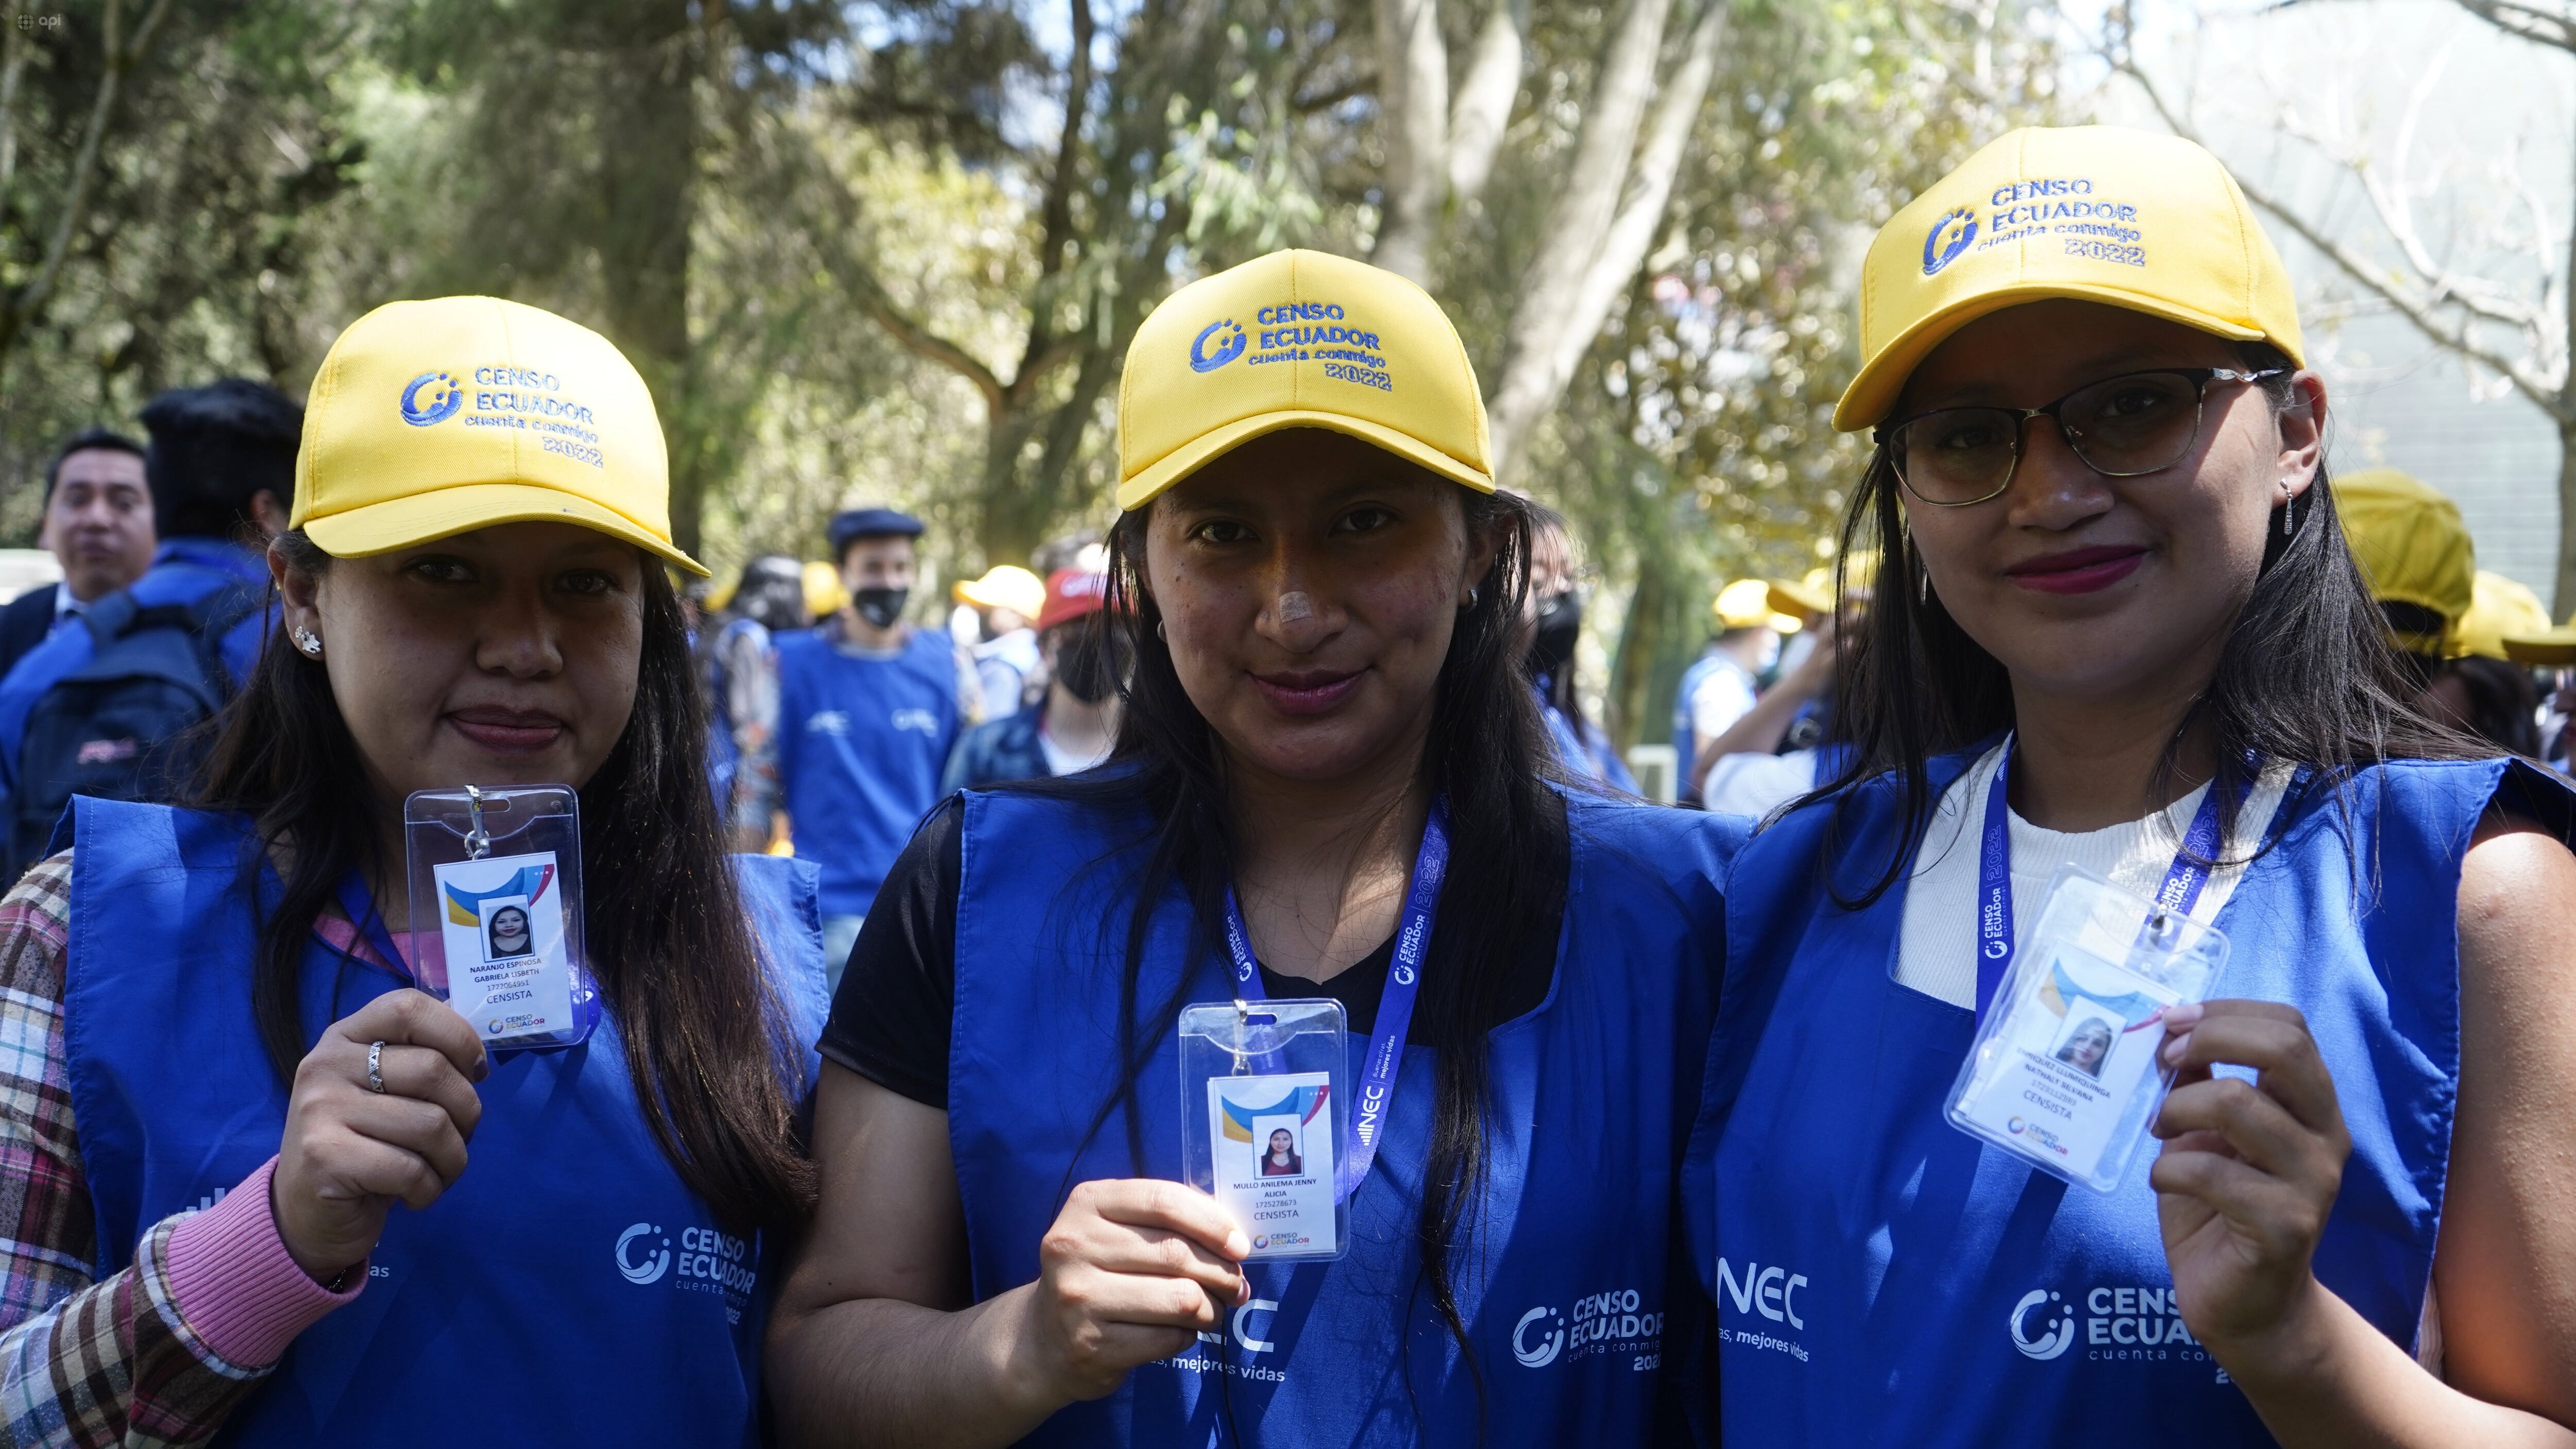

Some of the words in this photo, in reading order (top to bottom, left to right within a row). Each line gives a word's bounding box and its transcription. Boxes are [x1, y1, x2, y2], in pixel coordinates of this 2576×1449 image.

[1992, 178, 2093, 206] CENSO
[1993, 201, 2136, 232] ECUADOR
[2055, 223, 2141, 243] conmigo
[2065, 239, 2145, 267] 2022
[1258, 303, 1344, 325] CENSO
[1261, 327, 1381, 350] ECUADOR
[1249, 348, 1309, 365] cuenta
[1314, 349, 1386, 368] conmigo
[476, 366, 560, 391] CENSO
[1325, 363, 1392, 391] 2022
[477, 391, 594, 424] ECUADOR
[465, 415, 526, 429] cuenta
[532, 420, 598, 444] conmigo
[542, 437, 603, 468] 2022
[1987, 825, 2002, 880] 2022
[1416, 856, 1439, 908] 2022
[2168, 866, 2196, 910] CUADOR
[1985, 905, 1993, 939] CENSO
[1993, 887, 2003, 937] ECUADOR
[1228, 915, 1246, 961] ECUADOR
[1229, 933, 1242, 965] CENSO
[1399, 927, 1413, 961] CENSO
[1406, 914, 1426, 964] ECUADOR
[470, 963, 504, 973] NARANJO
[507, 958, 542, 968] ESPINOSA
[474, 973, 510, 982] GABRIELA
[512, 968, 539, 978] LISBETH
[487, 990, 532, 1004] CENSISTA
[505, 1014, 532, 1023] CENSO
[506, 1018, 545, 1029] ECUADOR
[1372, 1058, 1382, 1077] Buenas
[1380, 1053, 1391, 1079] mejores
[1387, 1035, 1395, 1052] vidas
[2023, 1089, 2072, 1121] CENSISTA
[2029, 1123, 2059, 1142] CENSO
[1254, 1210, 1299, 1220] CENSISTA
[1256, 1199, 1297, 1208] 1725278673
[682, 1227, 744, 1262] CENSO
[676, 1280, 723, 1294] cuenta
[677, 1252, 756, 1294] ECUADOR
[1573, 1289, 1640, 1322] CENSO
[1717, 1256, 1807, 1331] NEC
[2088, 1287, 2180, 1315] CENS
[2088, 1317, 2201, 1346] ECUA
[1568, 1344, 1605, 1363] cuenta
[1613, 1339, 1660, 1352] conmig
[1737, 1331, 1789, 1353] mejores
[1790, 1341, 1809, 1362] vidas
[2089, 1350, 2166, 1361] cuenta
[1172, 1355, 1236, 1375] mejores
[1241, 1365, 1285, 1382] vidas
